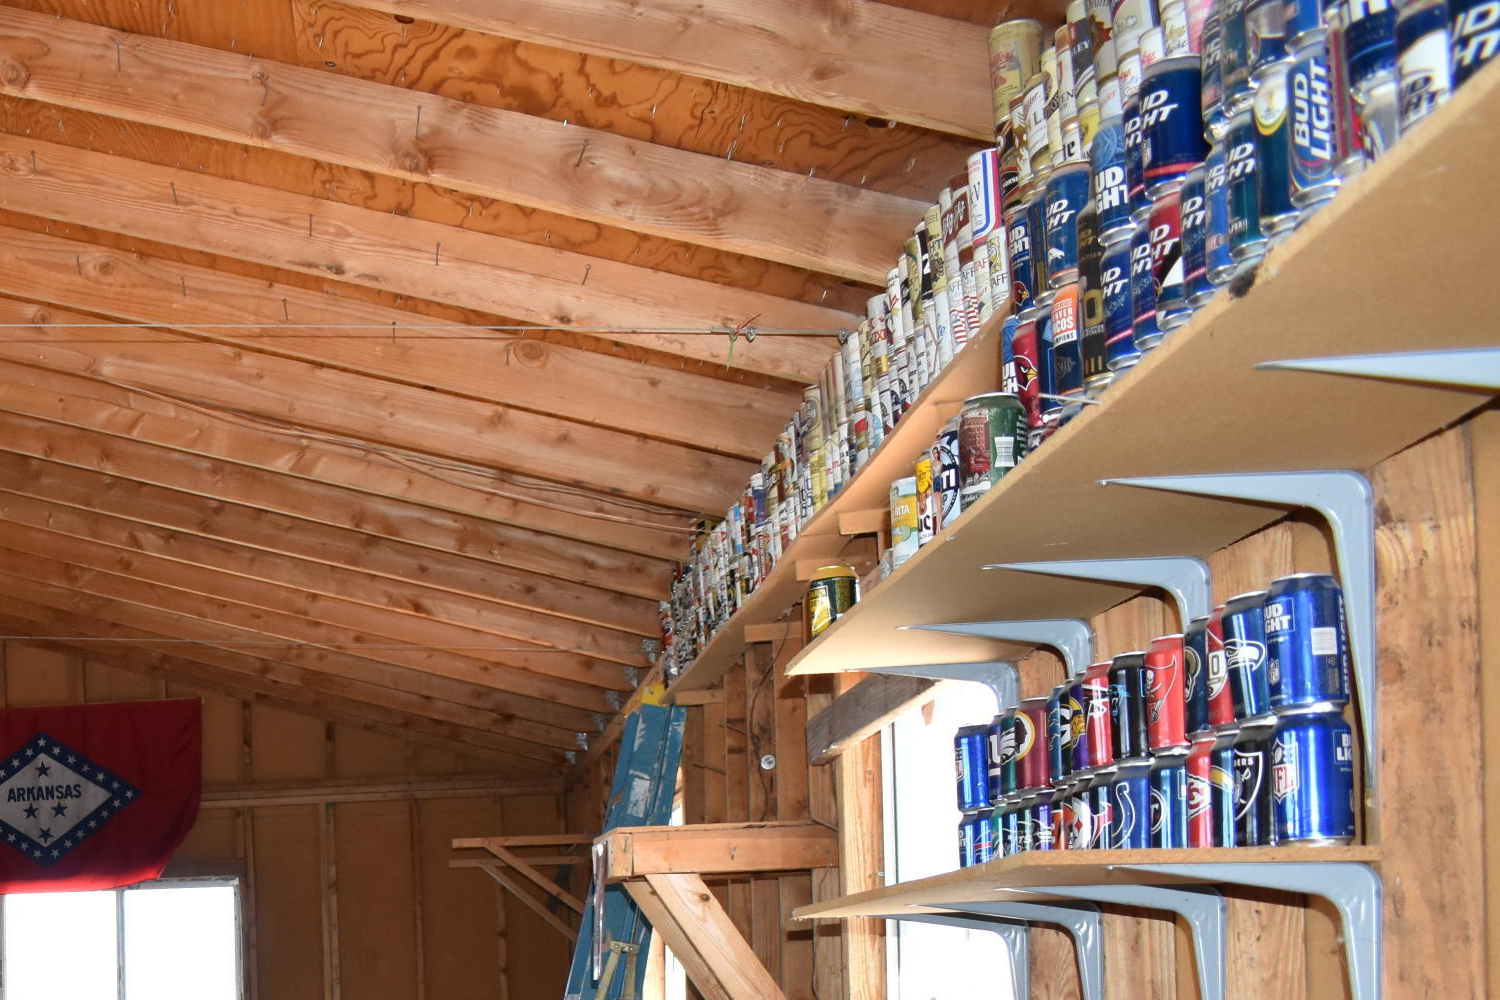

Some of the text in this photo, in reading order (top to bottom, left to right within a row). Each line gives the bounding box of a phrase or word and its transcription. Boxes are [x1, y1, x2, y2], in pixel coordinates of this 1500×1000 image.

[1294, 73, 1311, 148] BUD
[1309, 57, 1332, 160] LIGHT
[1095, 166, 1124, 192] UD
[1096, 185, 1129, 214] GHT
[1010, 225, 1026, 241] UD
[1264, 603, 1283, 618] UD
[1265, 615, 1291, 633] GHT
[7, 783, 82, 803] ARKANSAS
